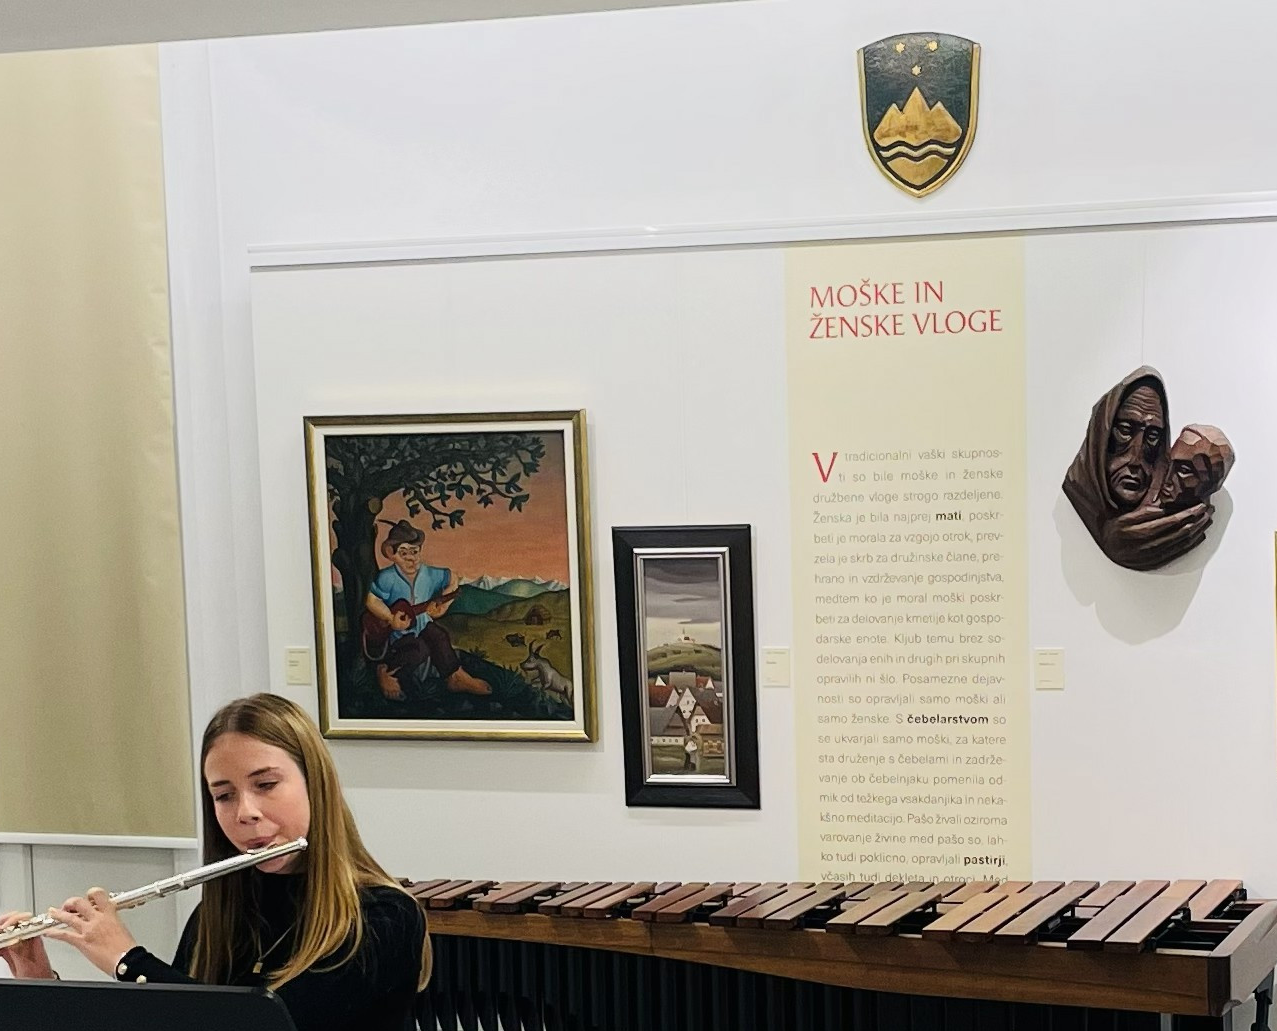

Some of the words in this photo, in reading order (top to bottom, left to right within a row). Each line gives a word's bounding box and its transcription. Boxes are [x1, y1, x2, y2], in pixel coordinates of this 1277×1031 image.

[810, 278, 905, 308] MOŠKE
[915, 281, 943, 303] IN
[809, 312, 905, 339] ŽENSKE
[913, 310, 1003, 335] VLOGE
[812, 452, 838, 483] V
[907, 713, 989, 724] čebelarstvom
